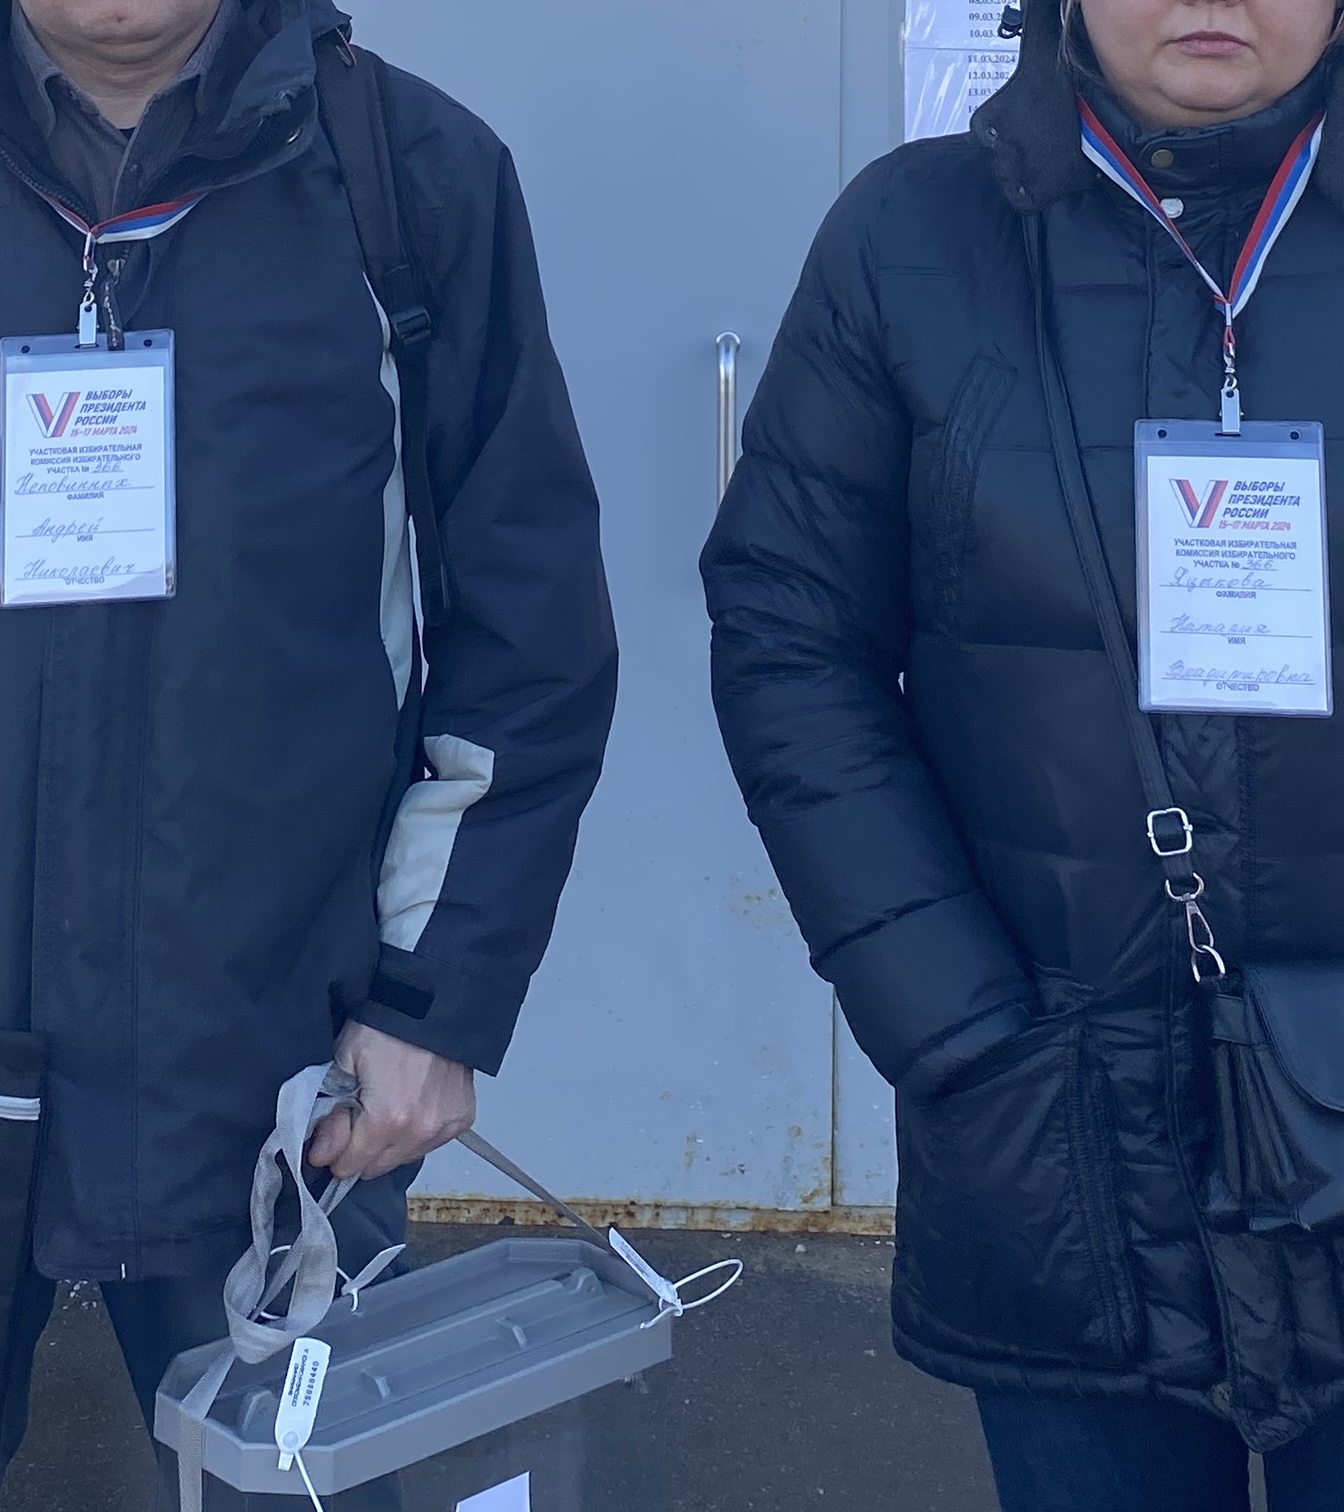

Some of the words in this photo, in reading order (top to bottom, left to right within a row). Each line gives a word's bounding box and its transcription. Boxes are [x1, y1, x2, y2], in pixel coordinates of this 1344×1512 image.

[969, 13, 1002, 22] 09.03.2
[968, 55, 1016, 64] 11.03.2024
[968, 71, 1010, 80] 12.03.202
[85, 389, 133, 401] ВЫБОРЫ
[80, 401, 146, 413] ПРЕЗИДЕНТА
[74, 415, 118, 426] РОССИИ
[29, 447, 78, 456] УЧАСТКОВАЯ
[79, 444, 142, 454] ИЗБИРАТЕЛЬНАЯ
[31, 456, 71, 465] КОМИССИЯ
[73, 453, 141, 463] ИЗБИРАТЕЛЬНОГО
[47, 465, 80, 474] УЧАСТКА
[1233, 481, 1286, 492] ВЫБОРЫ
[67, 492, 104, 500] ФАМИЛИЯ
[1228, 494, 1301, 506] ПРЕЗИДЕНТА
[1223, 508, 1269, 518] РОССИИ
[33, 517, 104, 543] Андрей
[1174, 539, 1226, 547] УЧАСТКОВАЯ
[1228, 540, 1297, 550] ИЗБИРАТЕЛЬНАЯ
[1176, 550, 1220, 558] КОМИССИЯ
[1222, 550, 1296, 560] ИЗБИРАТЕЛЬНОГО
[24, 556, 135, 579] Николаевич
[1194, 560, 1230, 568] УЧАСТКА
[65, 577, 105, 585] ОТЧЕСТВО
[1216, 591, 1256, 599] ФАМИЛИЯ
[1216, 683, 1259, 692] ОТЧЕСТВО
